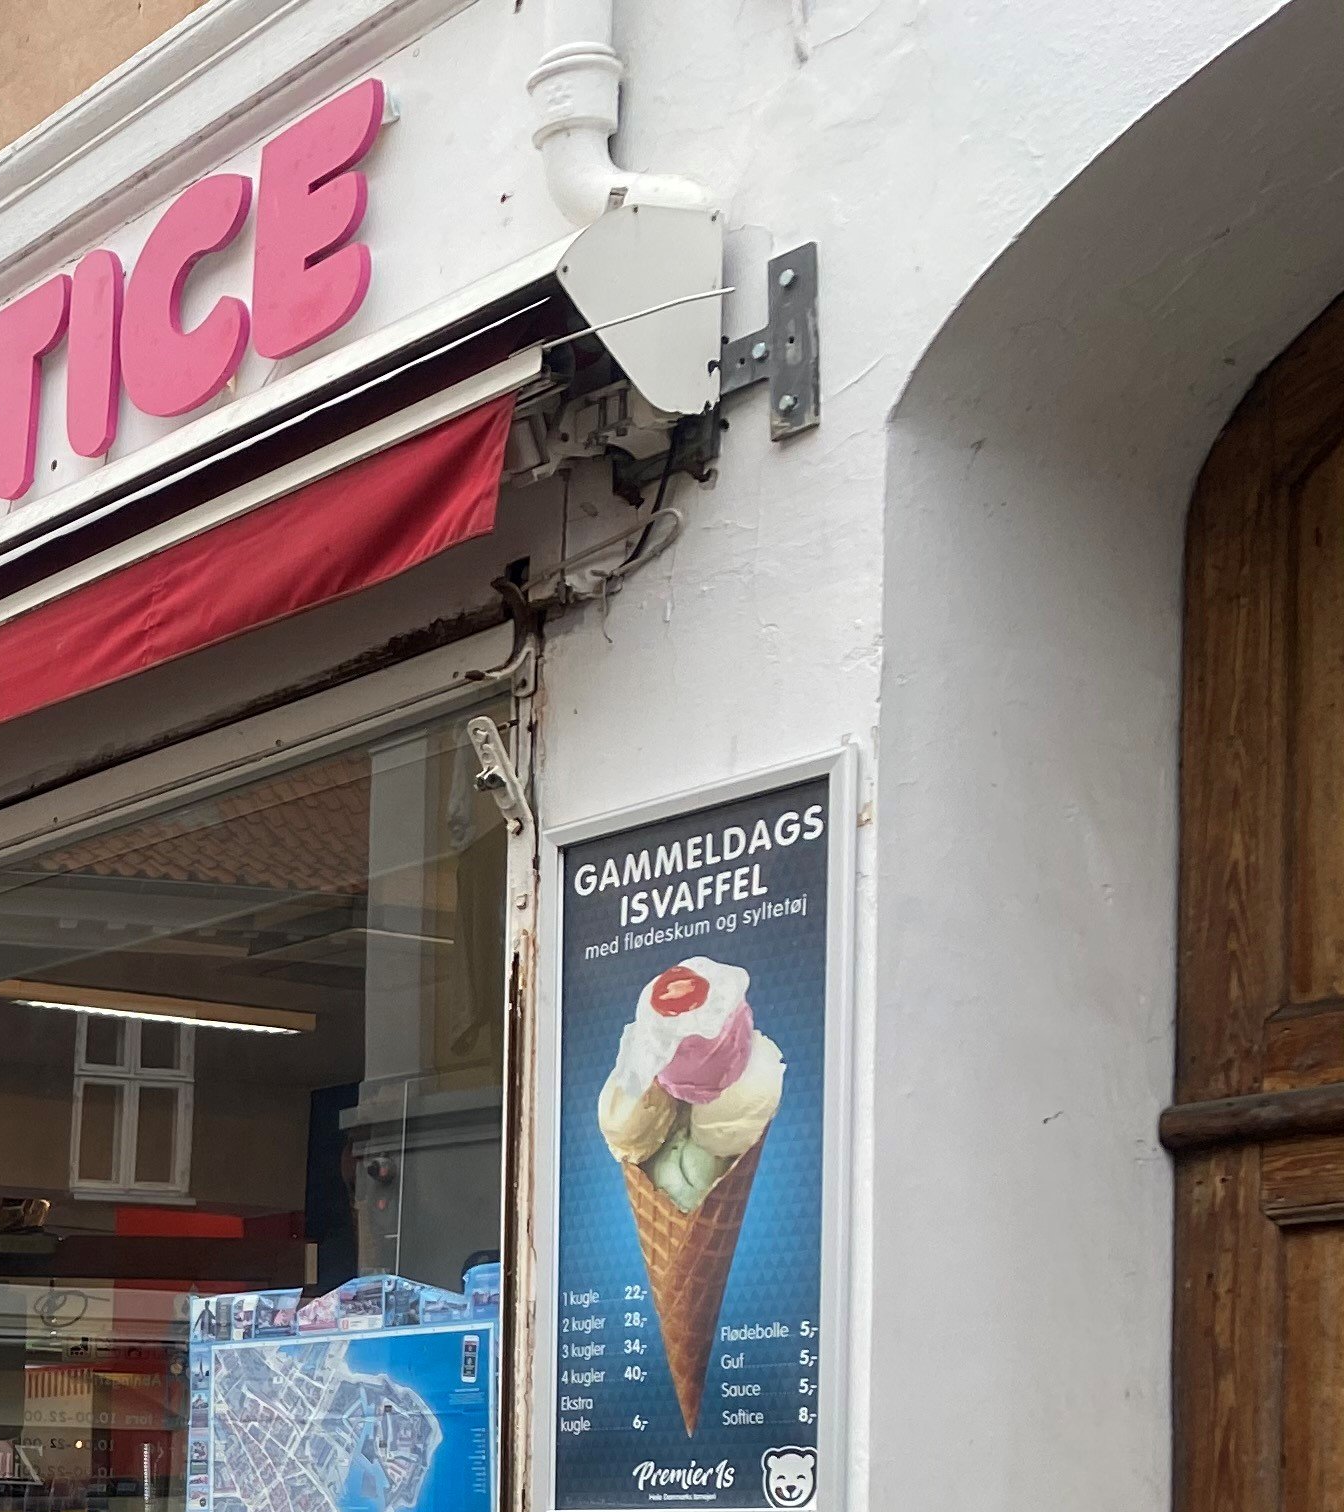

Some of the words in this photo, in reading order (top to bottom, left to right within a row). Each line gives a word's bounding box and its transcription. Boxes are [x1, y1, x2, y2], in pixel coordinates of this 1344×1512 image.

[574, 804, 824, 897] GAMMELDAGS
[620, 863, 768, 927] ISVAFFEL
[584, 936, 619, 960] med
[623, 918, 710, 951] flødeskum
[716, 913, 737, 933] og
[742, 893, 808, 927] syltetøj
[571, 1290, 599, 1308] kugle
[562, 1318, 569, 1332] 2
[571, 1315, 606, 1334] kugler
[720, 1321, 789, 1342] Flødebolle
[562, 1344, 569, 1358] 3
[571, 1341, 606, 1360] kugler
[720, 1352, 745, 1370] Guf
[562, 1371, 569, 1384] 4
[571, 1367, 606, 1386] kugler
[721, 1382, 761, 1398] Sauce
[561, 1396, 594, 1411] Ekstra
[561, 1416, 591, 1435] kugle
[722, 1408, 764, 1426] Softice
[632, 1459, 714, 1491] Premier
[715, 1459, 735, 1490] Is
